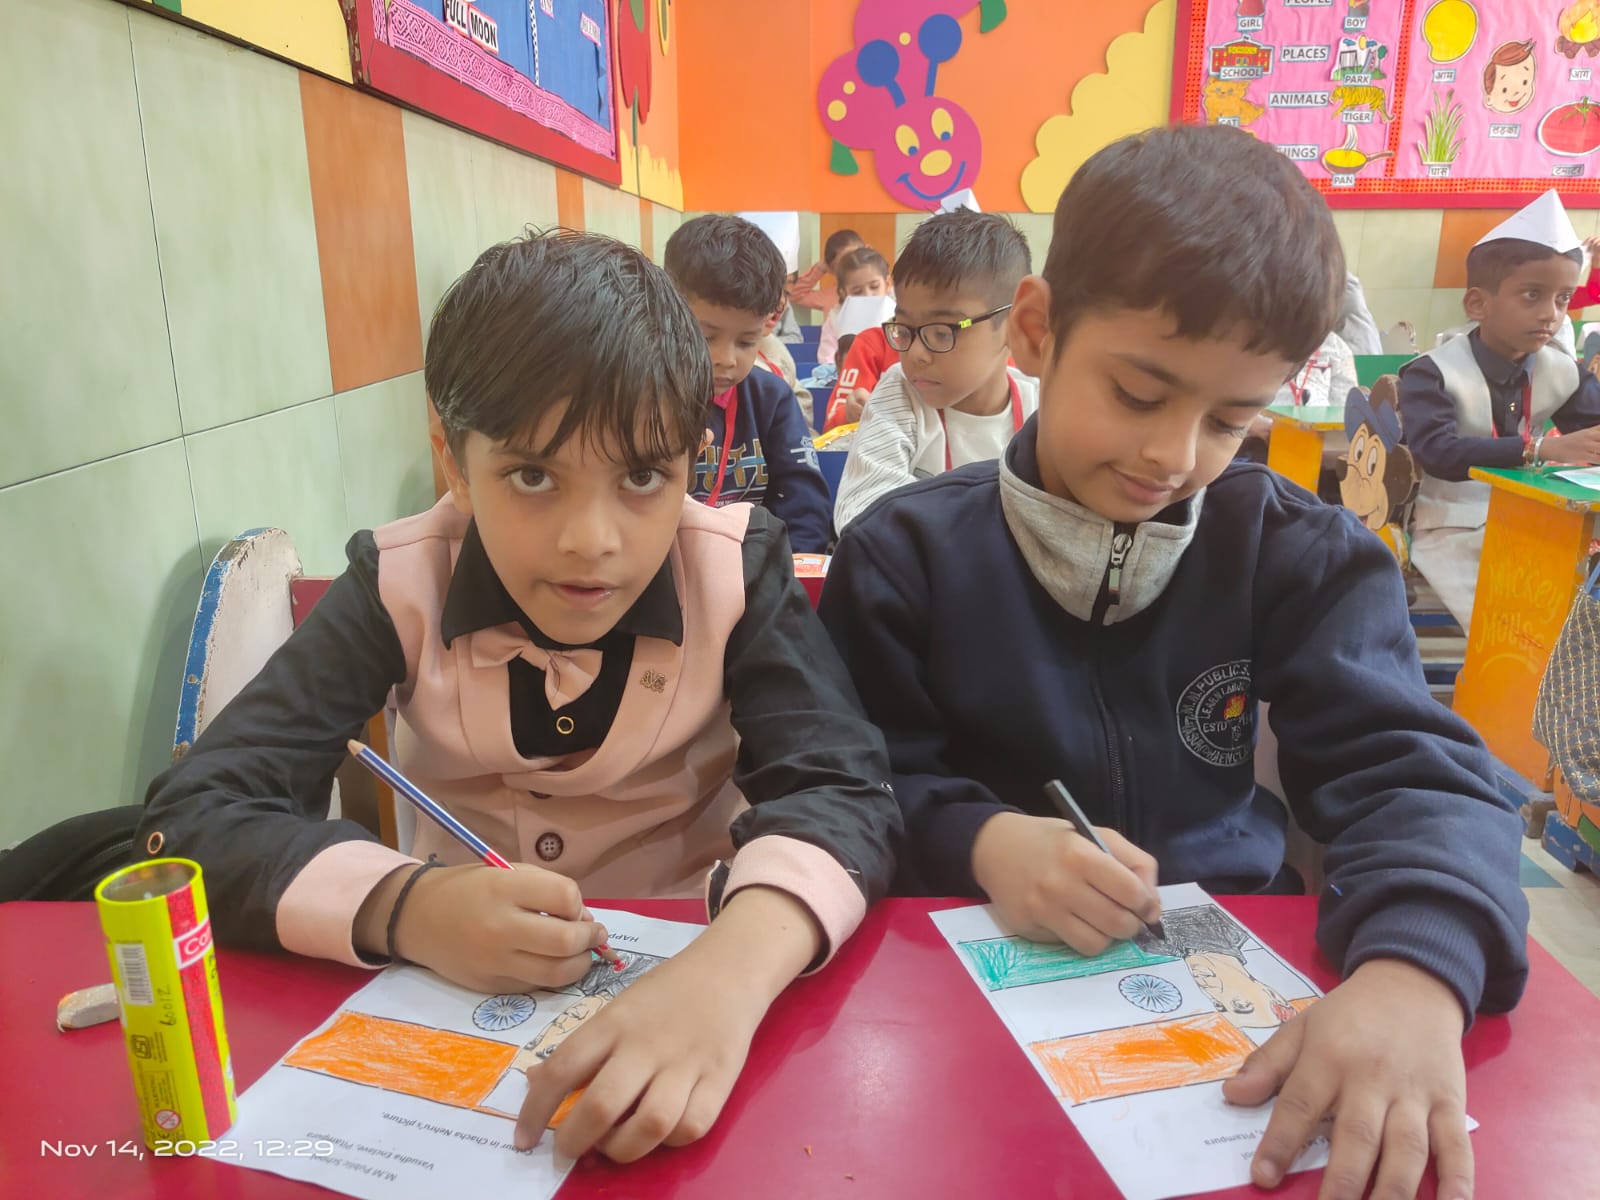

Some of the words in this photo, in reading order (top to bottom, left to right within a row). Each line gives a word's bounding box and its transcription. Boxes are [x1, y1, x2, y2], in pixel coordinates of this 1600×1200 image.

[1240, 18, 1261, 28] GIRL
[1346, 18, 1366, 27] BOY
[470, 11, 497, 48] MOON
[1283, 49, 1326, 59] PLACES
[1222, 68, 1261, 77] SCHOOL
[1345, 75, 1369, 84] PARK
[1271, 94, 1327, 105] ANIMALS
[1343, 112, 1371, 121] TIGER
[1334, 175, 1353, 184] PAN
[608, 932, 640, 943] HAPP
[454, 1130, 489, 1145] Chacha
